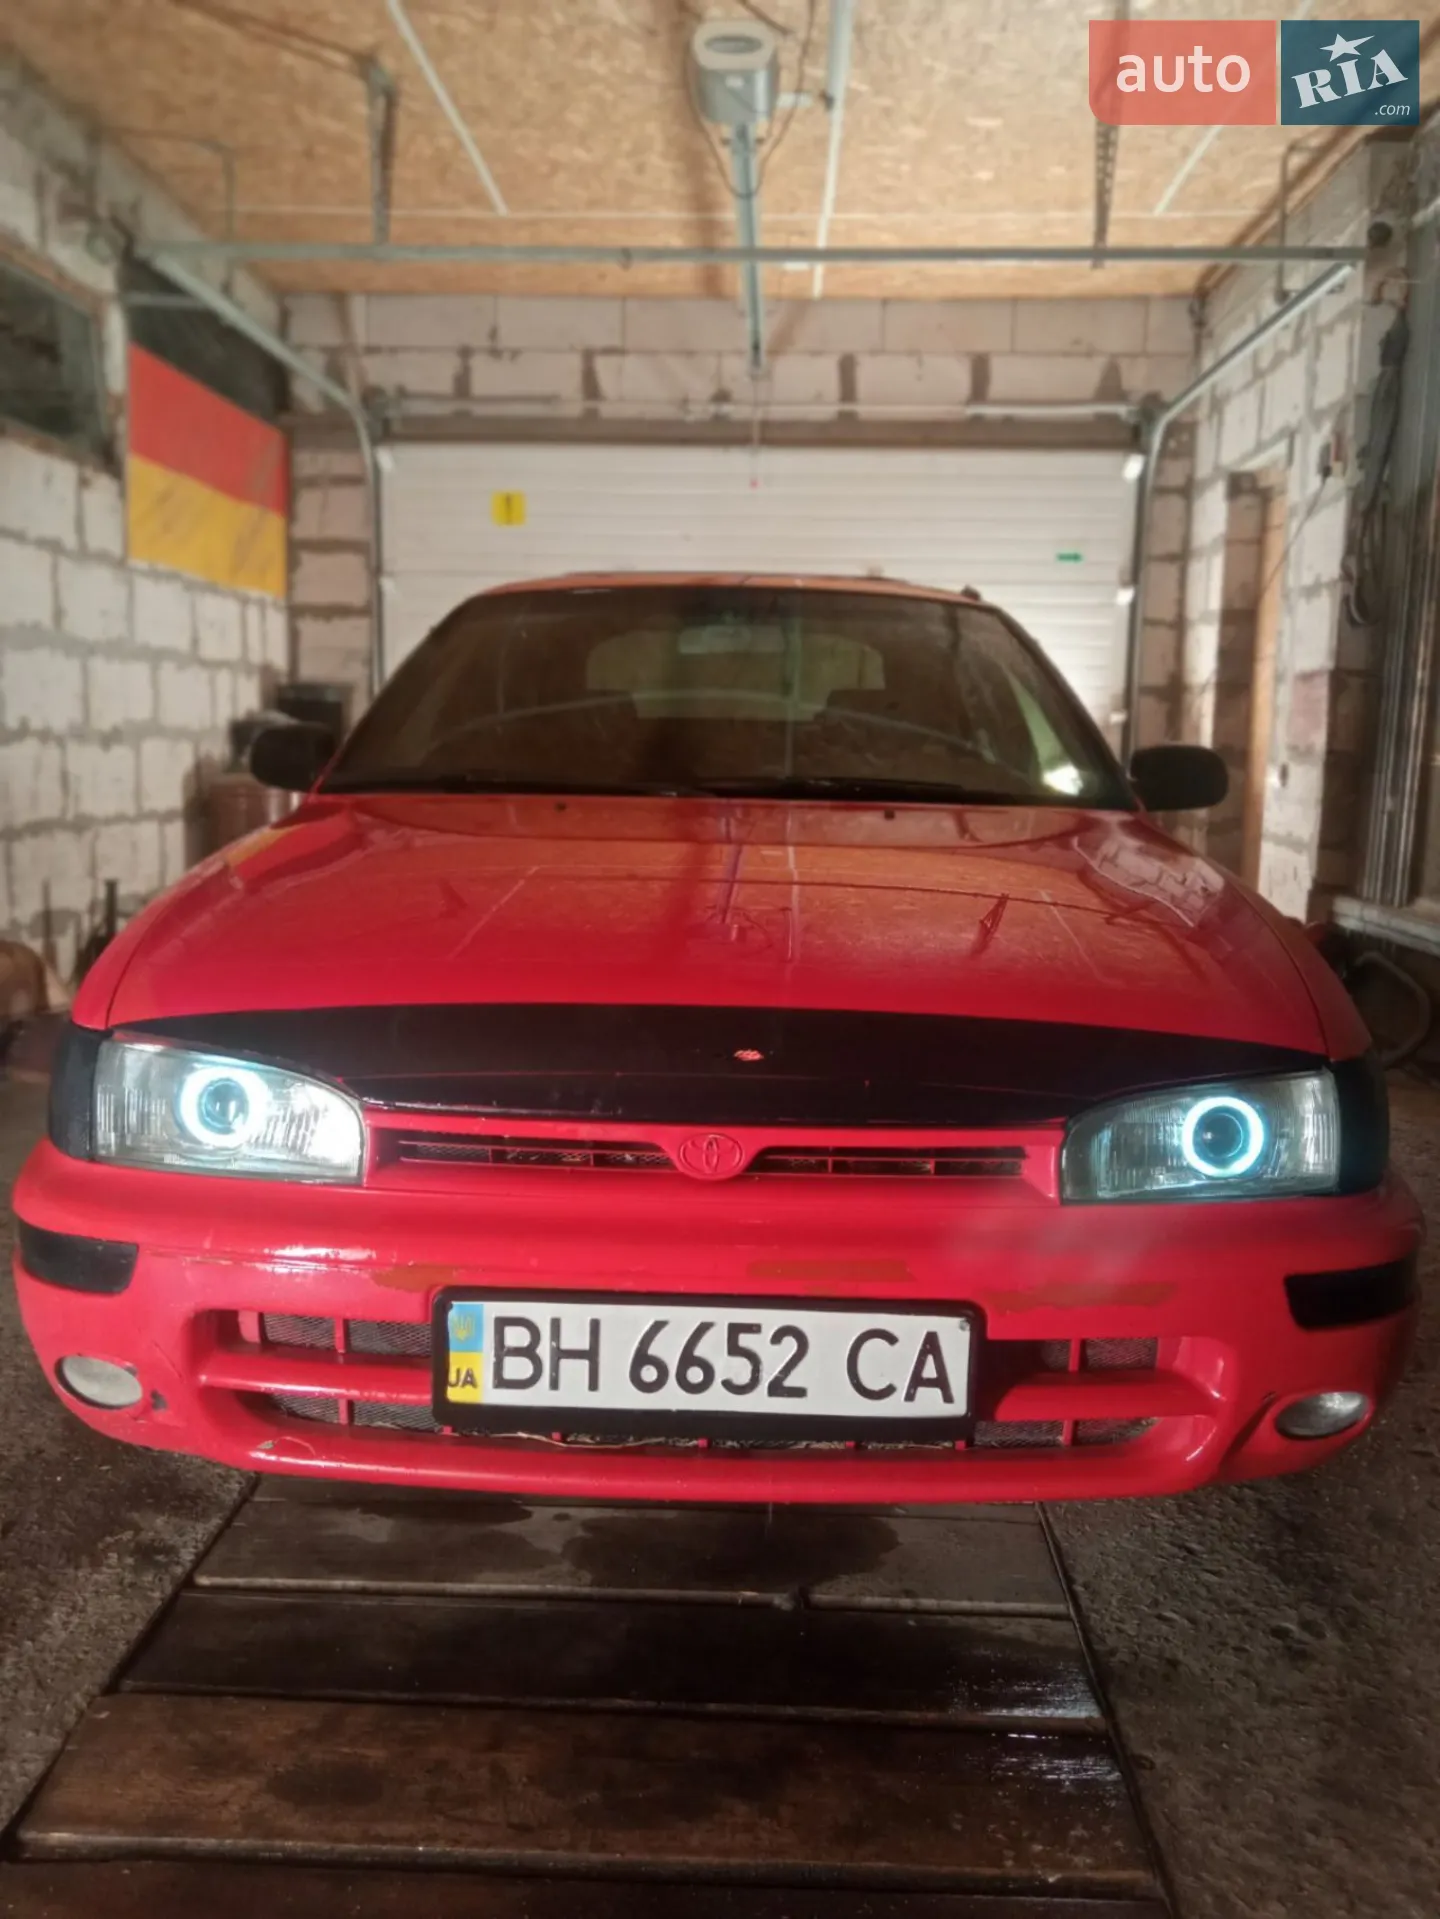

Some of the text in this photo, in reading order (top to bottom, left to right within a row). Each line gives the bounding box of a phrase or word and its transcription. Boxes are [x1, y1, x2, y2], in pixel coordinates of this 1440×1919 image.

[492, 1315, 956, 1404] BH 6652 CA
